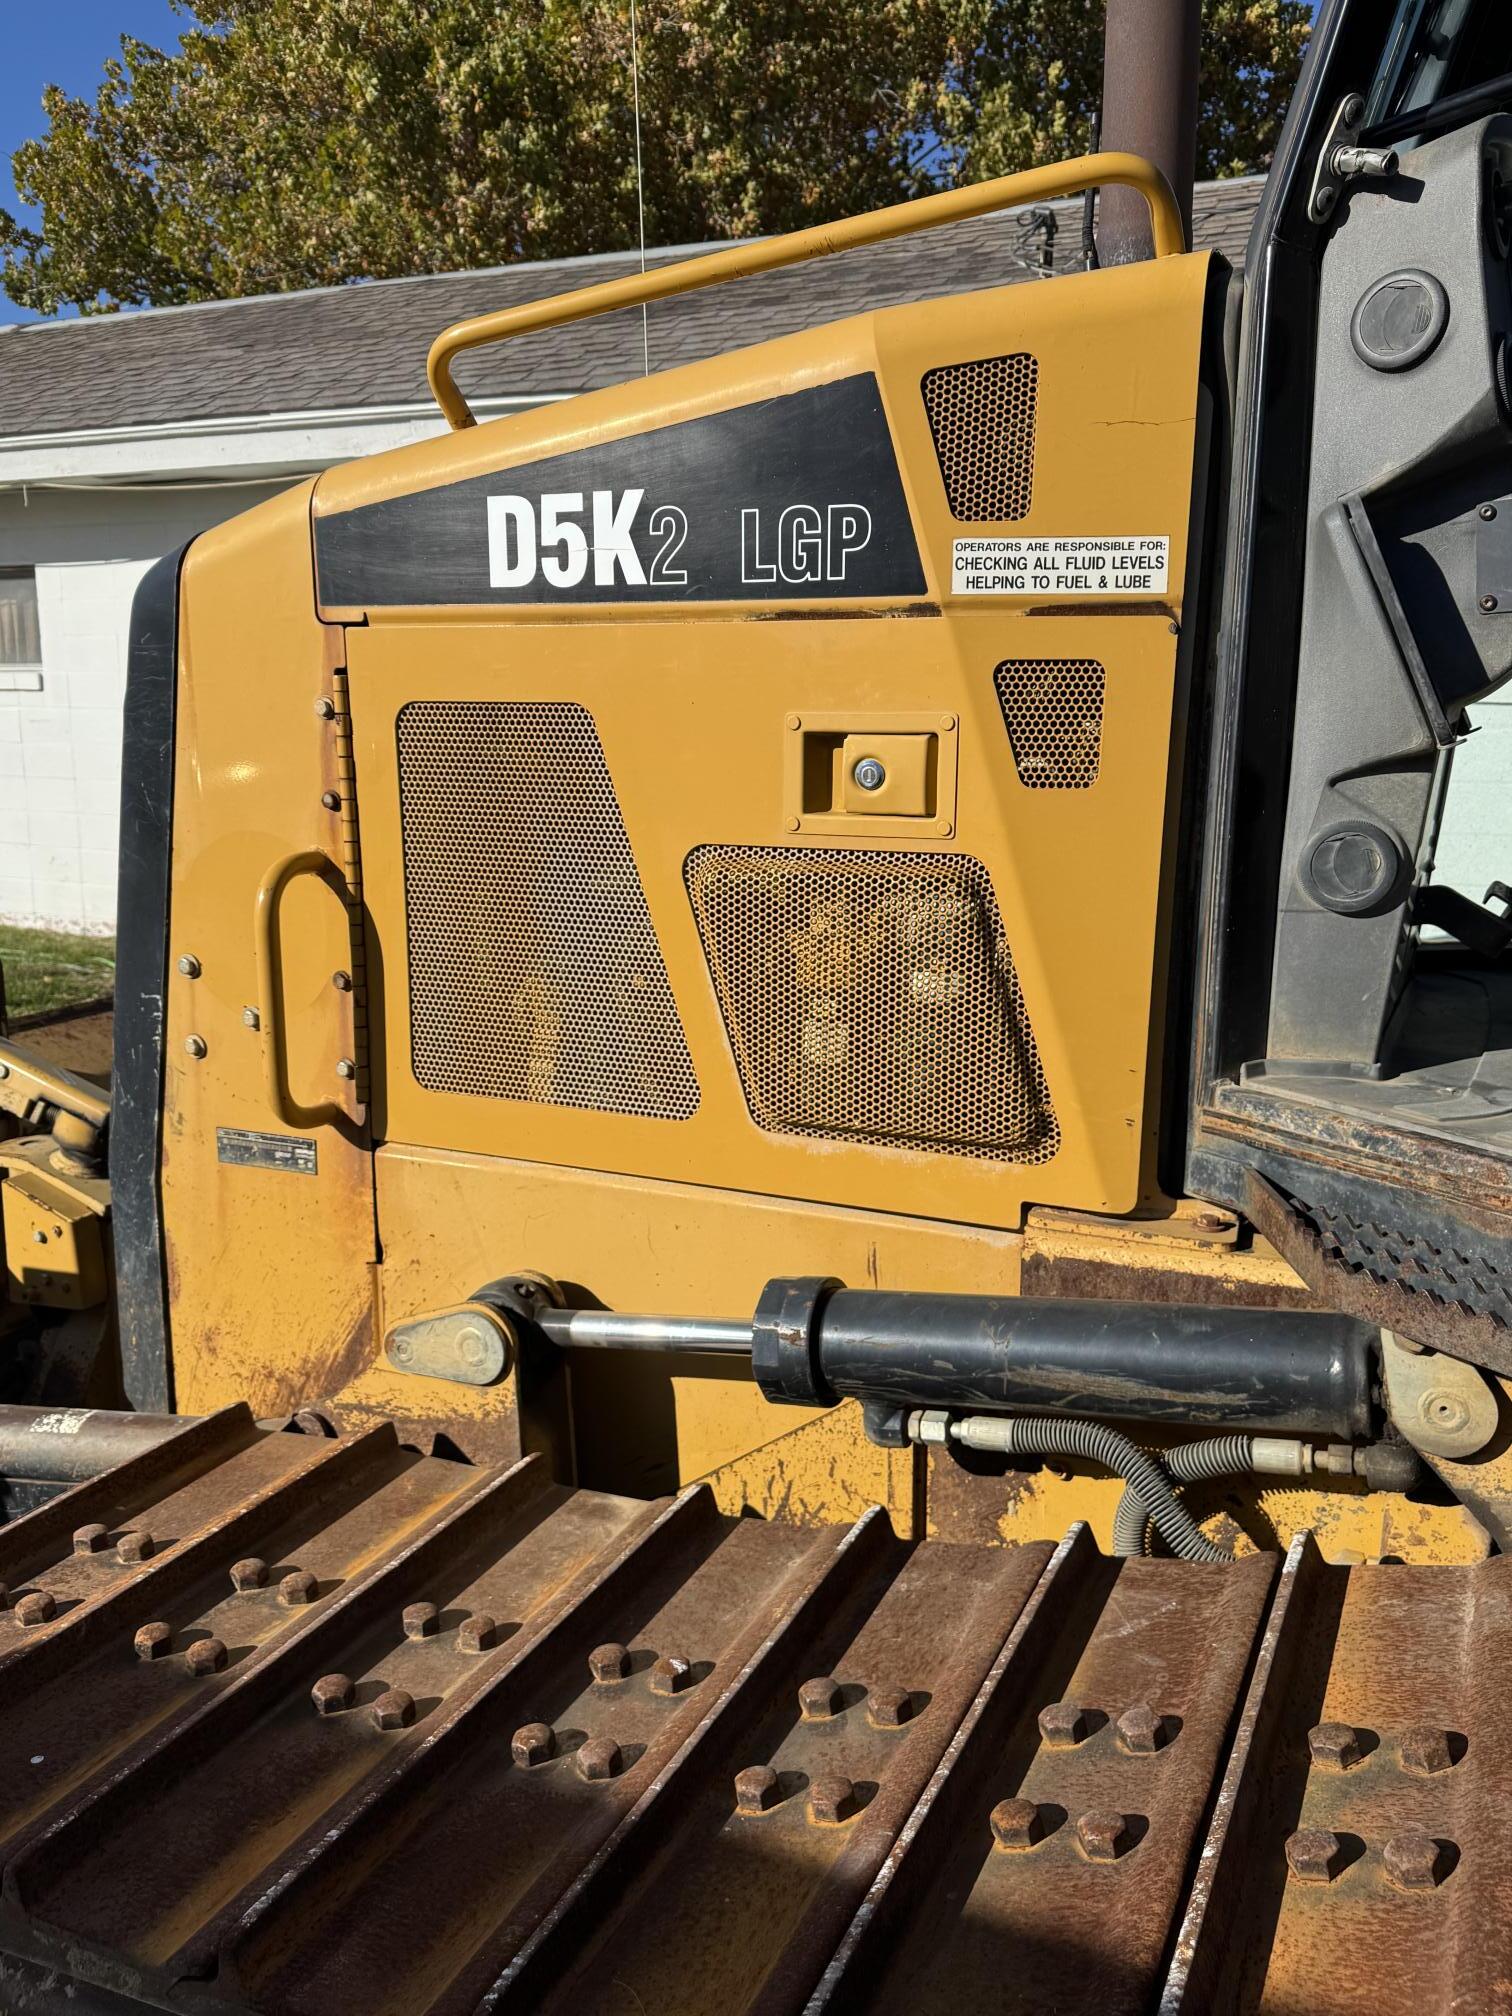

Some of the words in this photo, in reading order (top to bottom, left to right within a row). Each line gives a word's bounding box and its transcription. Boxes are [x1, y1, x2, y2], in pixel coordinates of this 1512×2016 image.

[486, 488, 688, 588] D5K2
[740, 503, 872, 583] LGP
[955, 542, 1022, 552] OPERATORS
[1026, 542, 1050, 552] ARE
[1054, 541, 1135, 551] RESPONSIBLE
[1139, 541, 1166, 551] FOR:
[955, 556, 1028, 571] CHECKING
[1033, 556, 1060, 570] ALL
[1065, 556, 1106, 570] FLUID
[1111, 555, 1165, 570] LEVELS
[966, 575, 1025, 589] HELPING
[1031, 575, 1050, 589] TO
[1056, 575, 1092, 589] FUEL
[1098, 575, 1108, 589] &
[1115, 575, 1152, 589] LUBE
